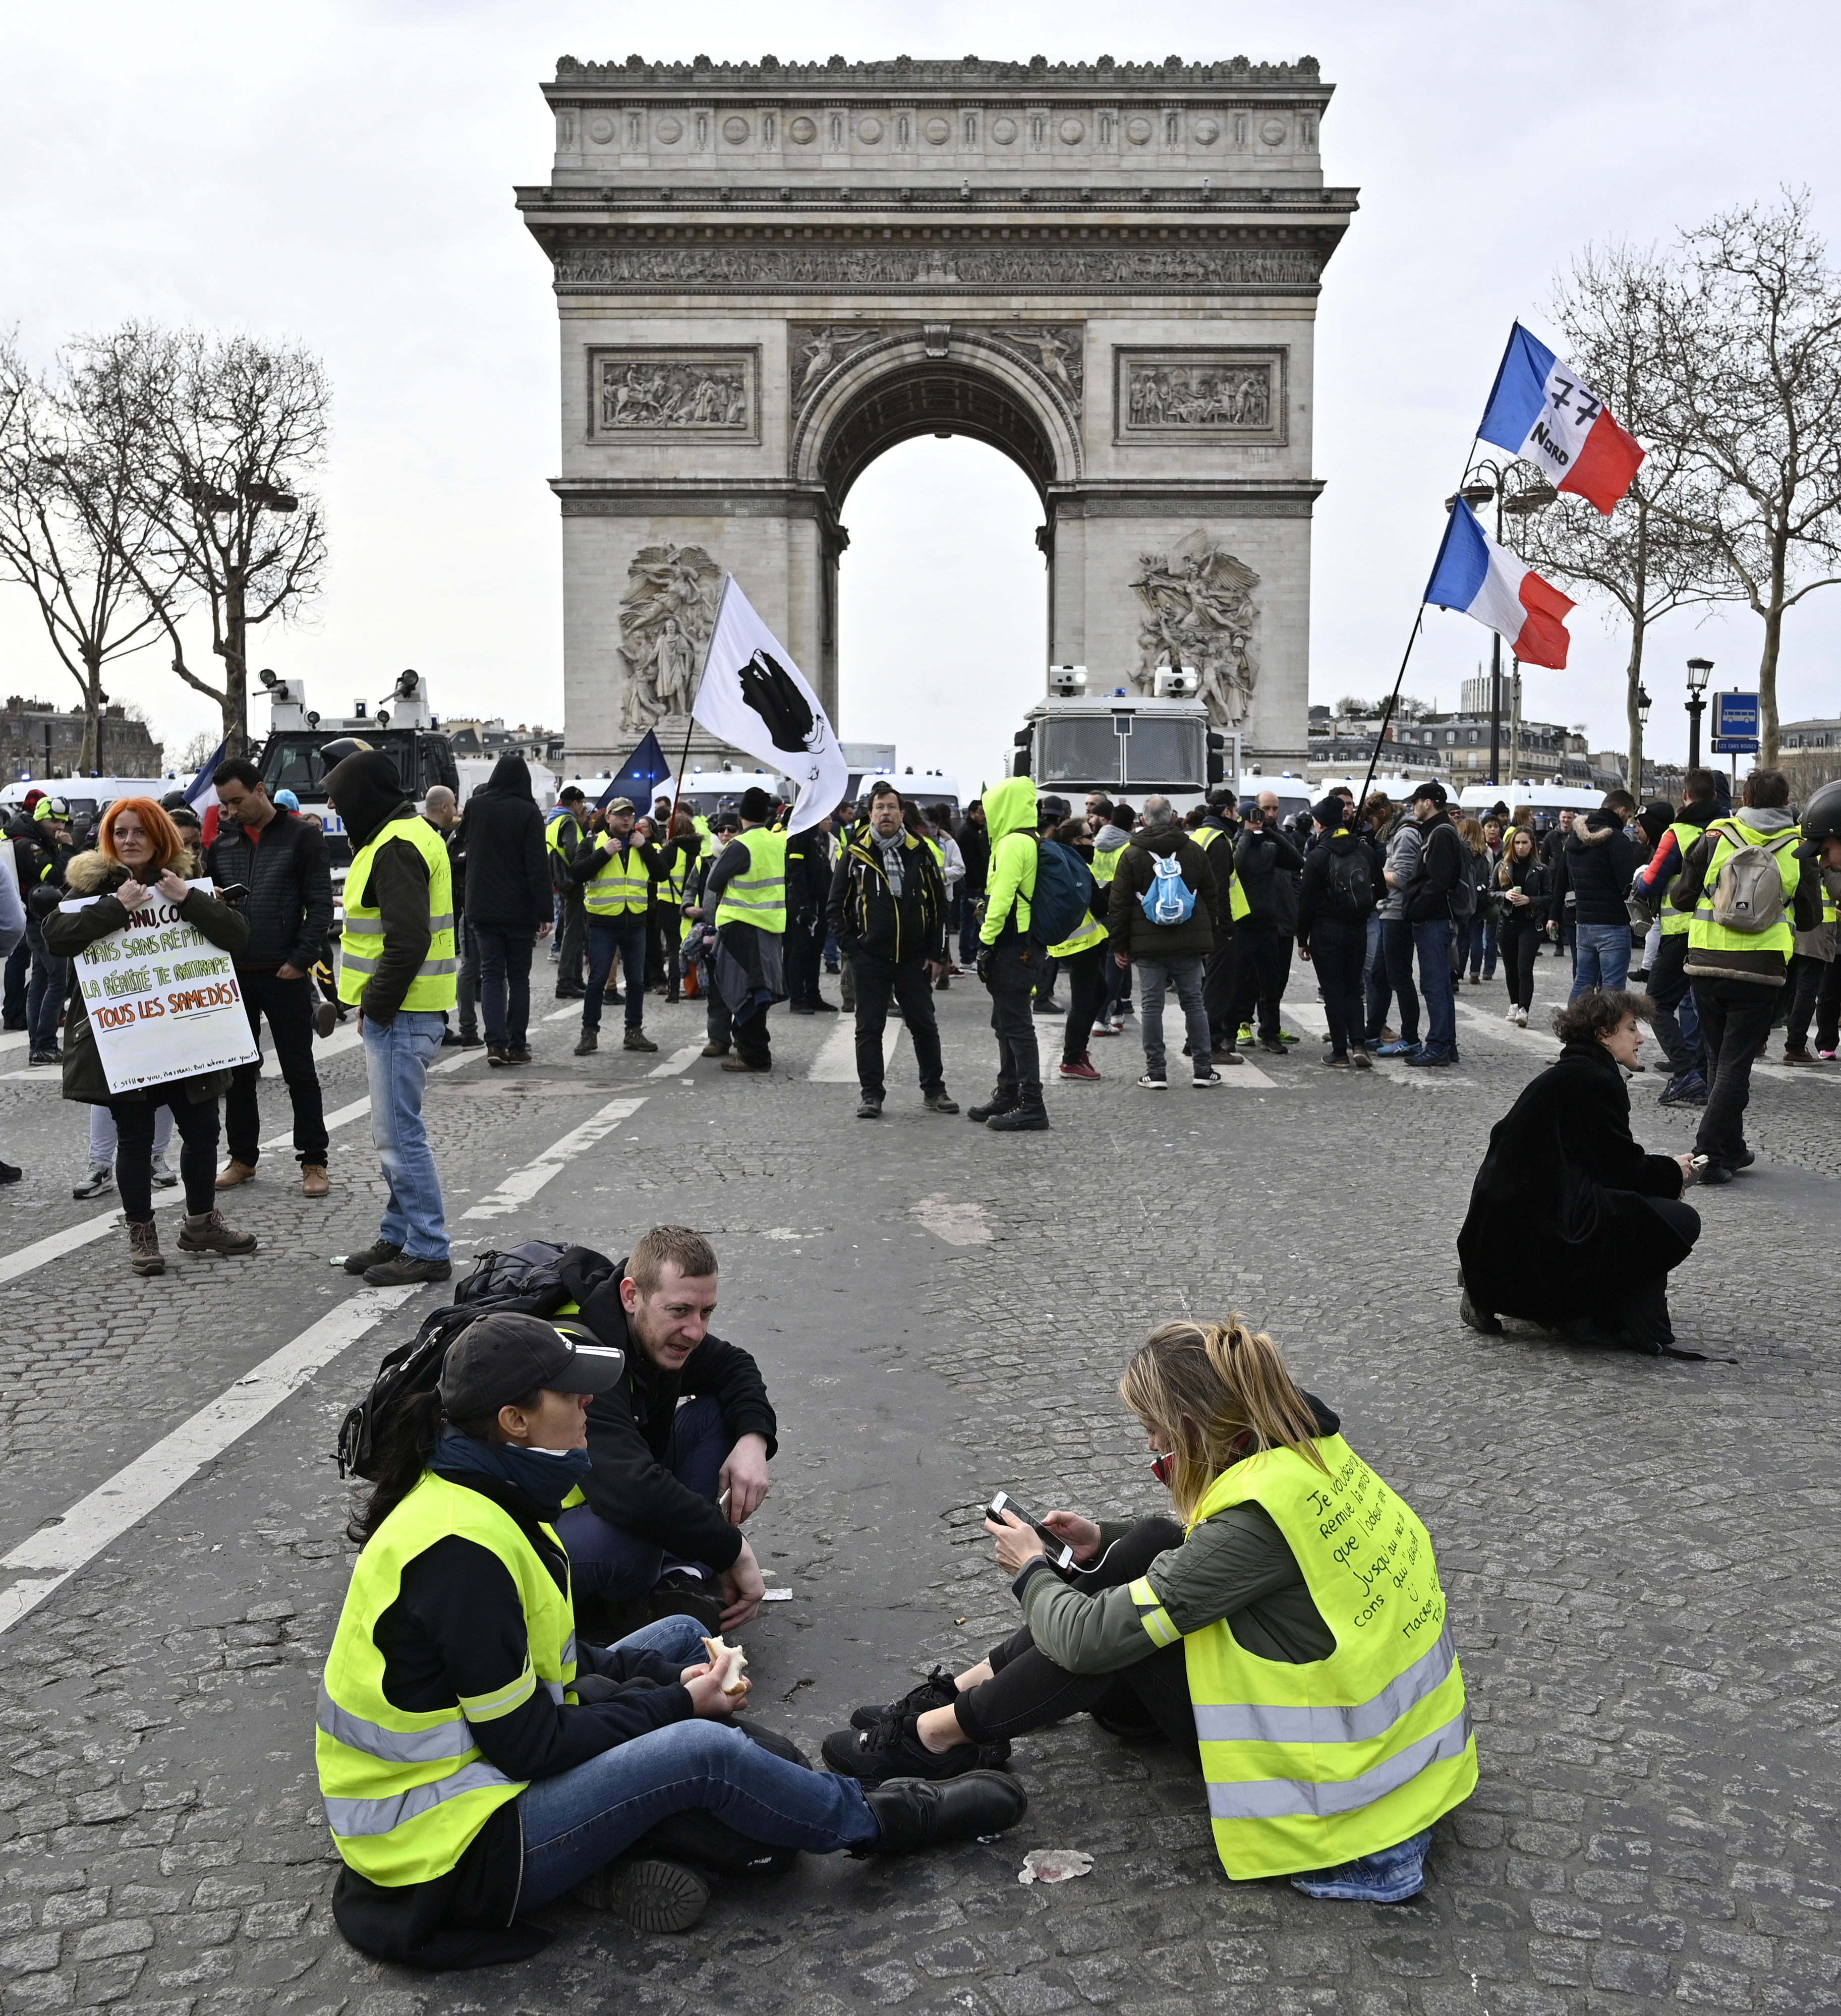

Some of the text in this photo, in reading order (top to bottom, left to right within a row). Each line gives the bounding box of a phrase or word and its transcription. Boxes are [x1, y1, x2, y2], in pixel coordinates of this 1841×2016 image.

[1551, 376, 1600, 426] 77
[124, 908, 160, 932] ANU,
[122, 934, 160, 959] SANS
[82, 979, 101, 999] LA
[153, 966, 171, 987] TE
[173, 956, 231, 981] RATTRAPE
[91, 1003, 136, 1029] TOUS
[137, 997, 165, 1019] LES
[112, 1081, 118, 1089] I
[1306, 1489, 1332, 1516] Je
[1350, 1490, 1363, 1504] la
[1333, 1535, 1360, 1568] que
[1393, 1562, 1408, 1589] qui
